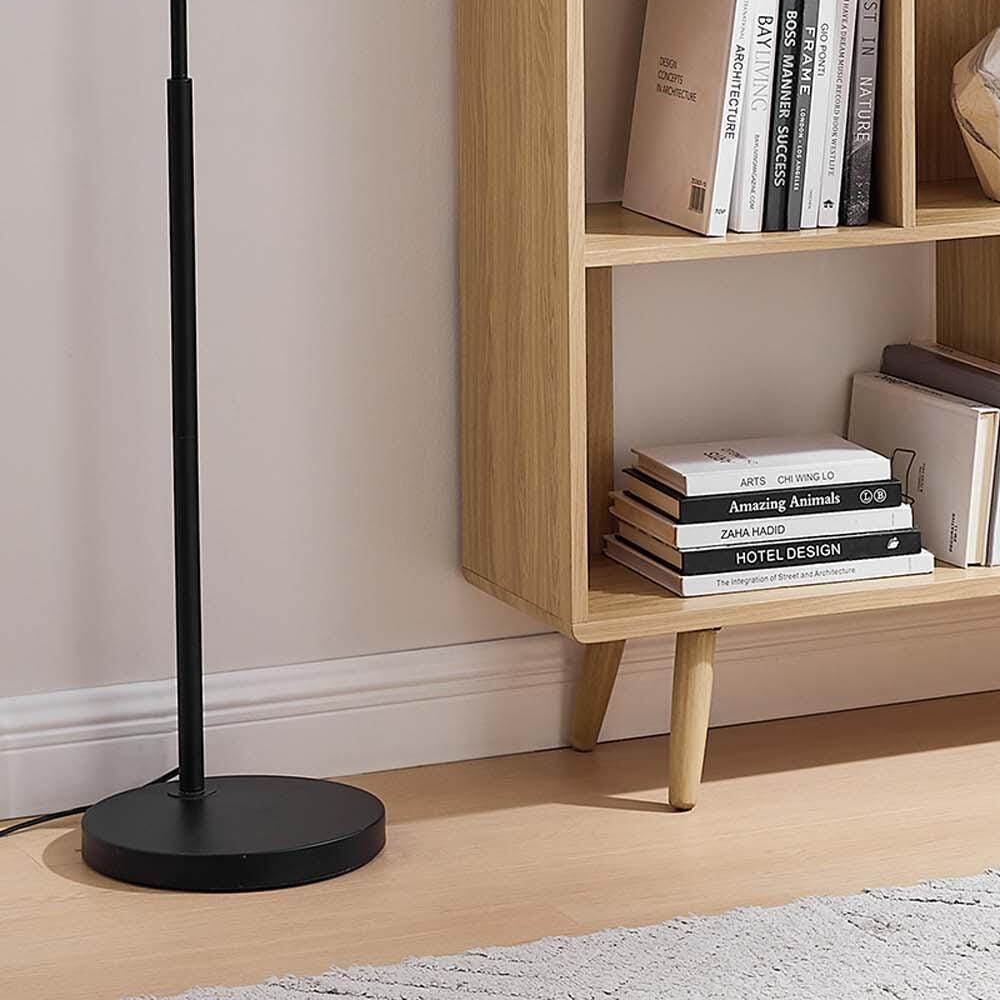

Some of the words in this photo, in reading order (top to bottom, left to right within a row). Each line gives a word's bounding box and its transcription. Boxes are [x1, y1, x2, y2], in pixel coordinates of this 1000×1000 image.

[784, 10, 798, 47] BOSS
[819, 23, 829, 43] GIO
[862, 36, 876, 56] IN
[800, 26, 815, 95] FRAME
[818, 45, 827, 77] PONTI
[724, 44, 745, 140] ARCHITECTURE
[779, 54, 794, 119] MANNER
[857, 76, 873, 141] NATURE
[774, 126, 789, 187] SUCCESS
[740, 475, 766, 487] ARTS
[777, 474, 793, 485] CHI
[795, 472, 820, 483] WING
[822, 471, 835, 481] LO
[729, 498, 786, 514] Amazing
[789, 491, 841, 508] Animals
[721, 528, 750, 540] ZAHA
[751, 525, 786, 537] HADID
[736, 549, 784, 565] HOTEL
[786, 543, 841, 560] DESIGN
[717, 579, 729, 587] The
[731, 576, 768, 586] Integration
[770, 574, 777, 582] of
[778, 572, 799, 581] Street
[800, 570, 813, 579] and
[814, 567, 856, 577] Architecture
